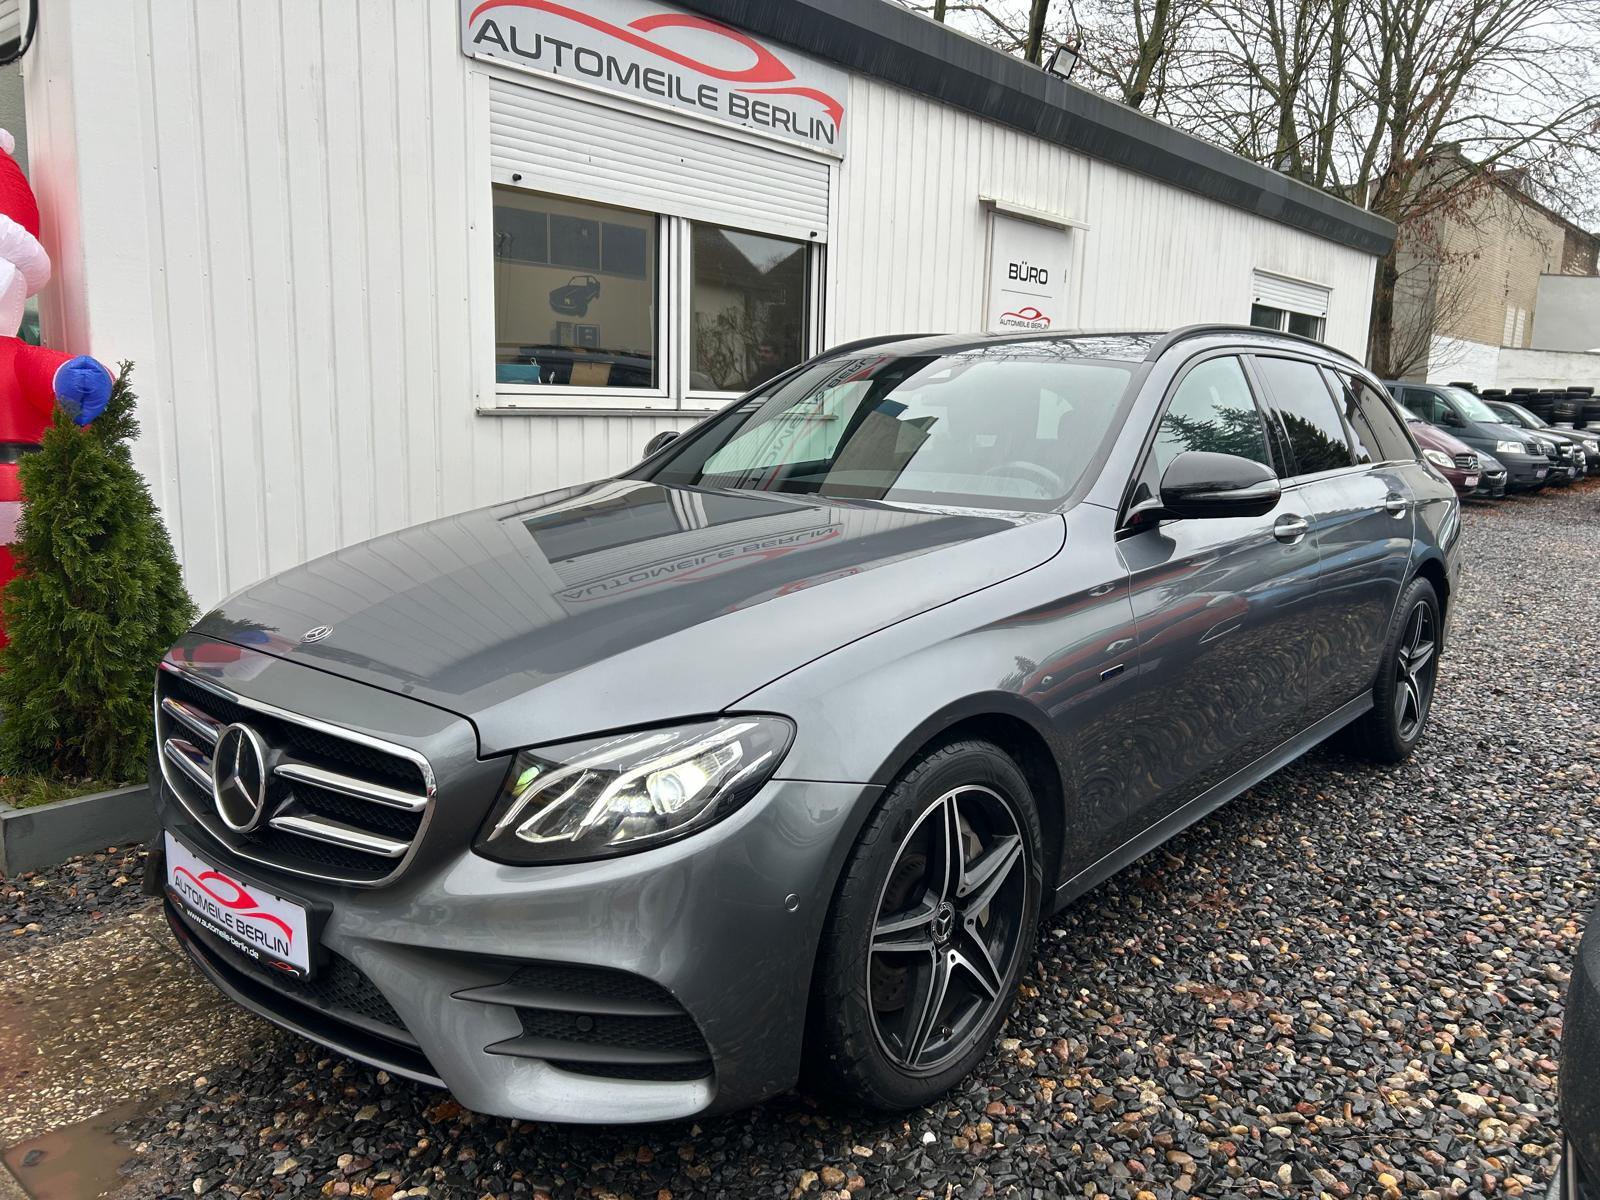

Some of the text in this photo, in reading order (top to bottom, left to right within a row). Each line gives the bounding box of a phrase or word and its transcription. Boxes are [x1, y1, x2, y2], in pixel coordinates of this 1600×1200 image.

[473, 18, 835, 145] AUTOMEILE BERLIN
[1008, 260, 1049, 285] BÜRO
[174, 876, 289, 957] AUTOMEILE BERLIN
[187, 909, 259, 959] www.automeile-berlin.de
